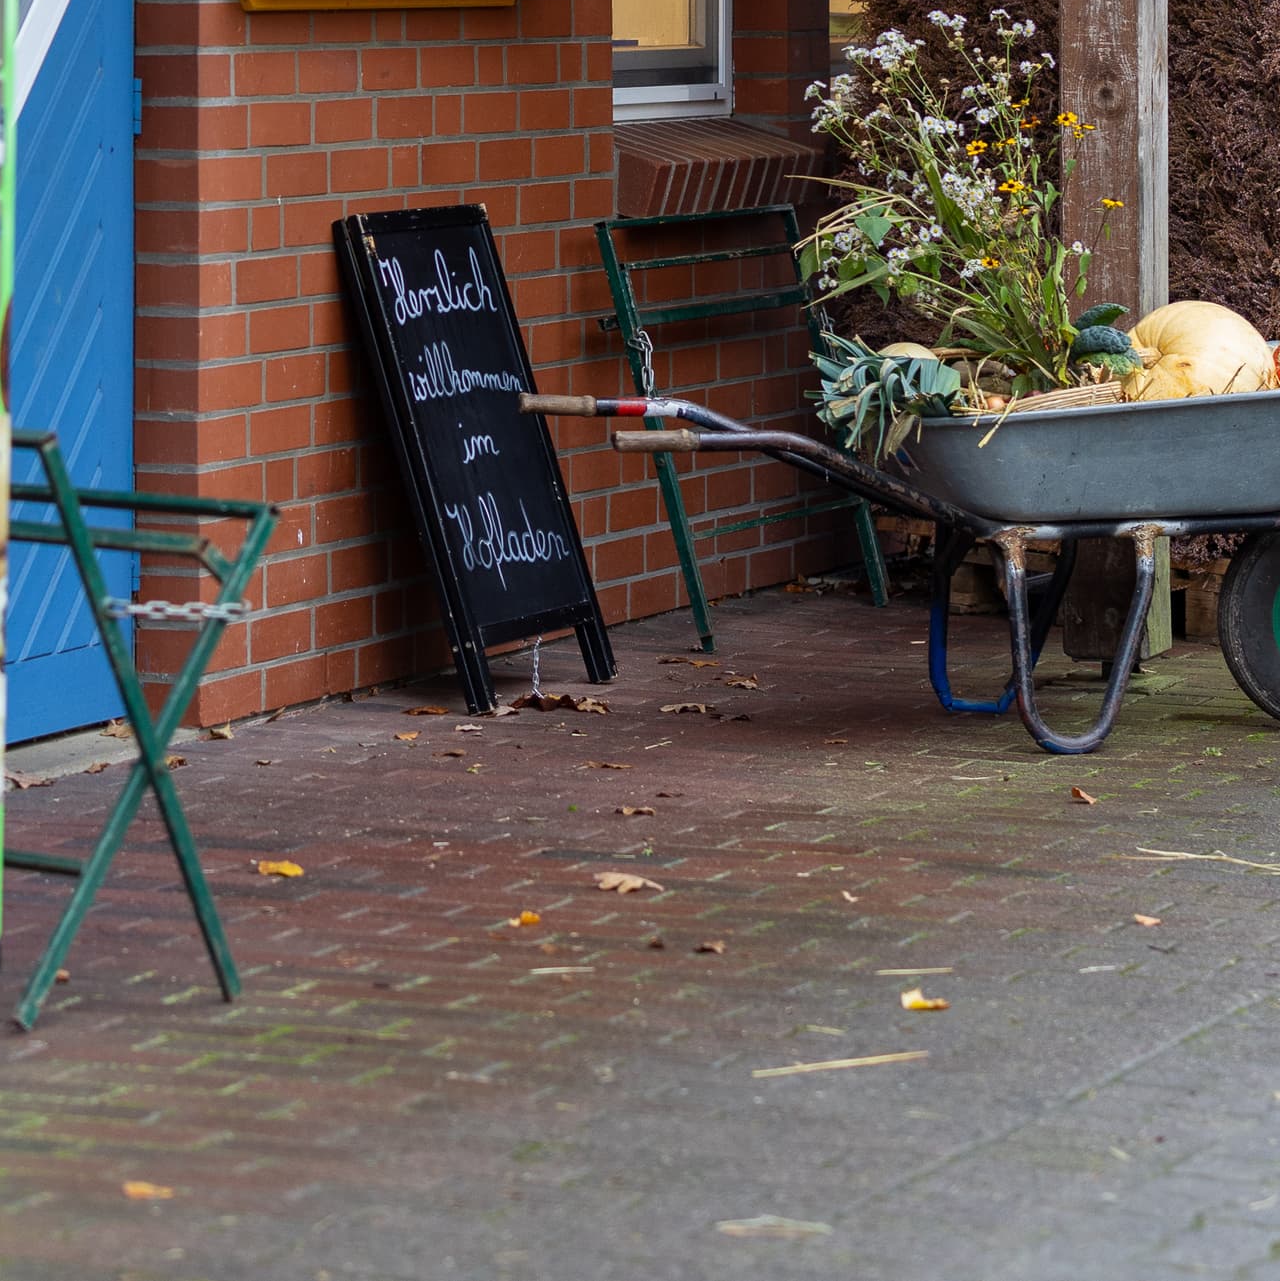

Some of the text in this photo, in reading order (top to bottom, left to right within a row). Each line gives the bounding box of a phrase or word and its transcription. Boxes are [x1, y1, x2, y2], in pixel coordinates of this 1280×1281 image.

[377, 246, 498, 326] Herzlich
[408, 340, 523, 403] willkommen
[458, 422, 500, 464] im
[444, 491, 570, 592] Hofladen
